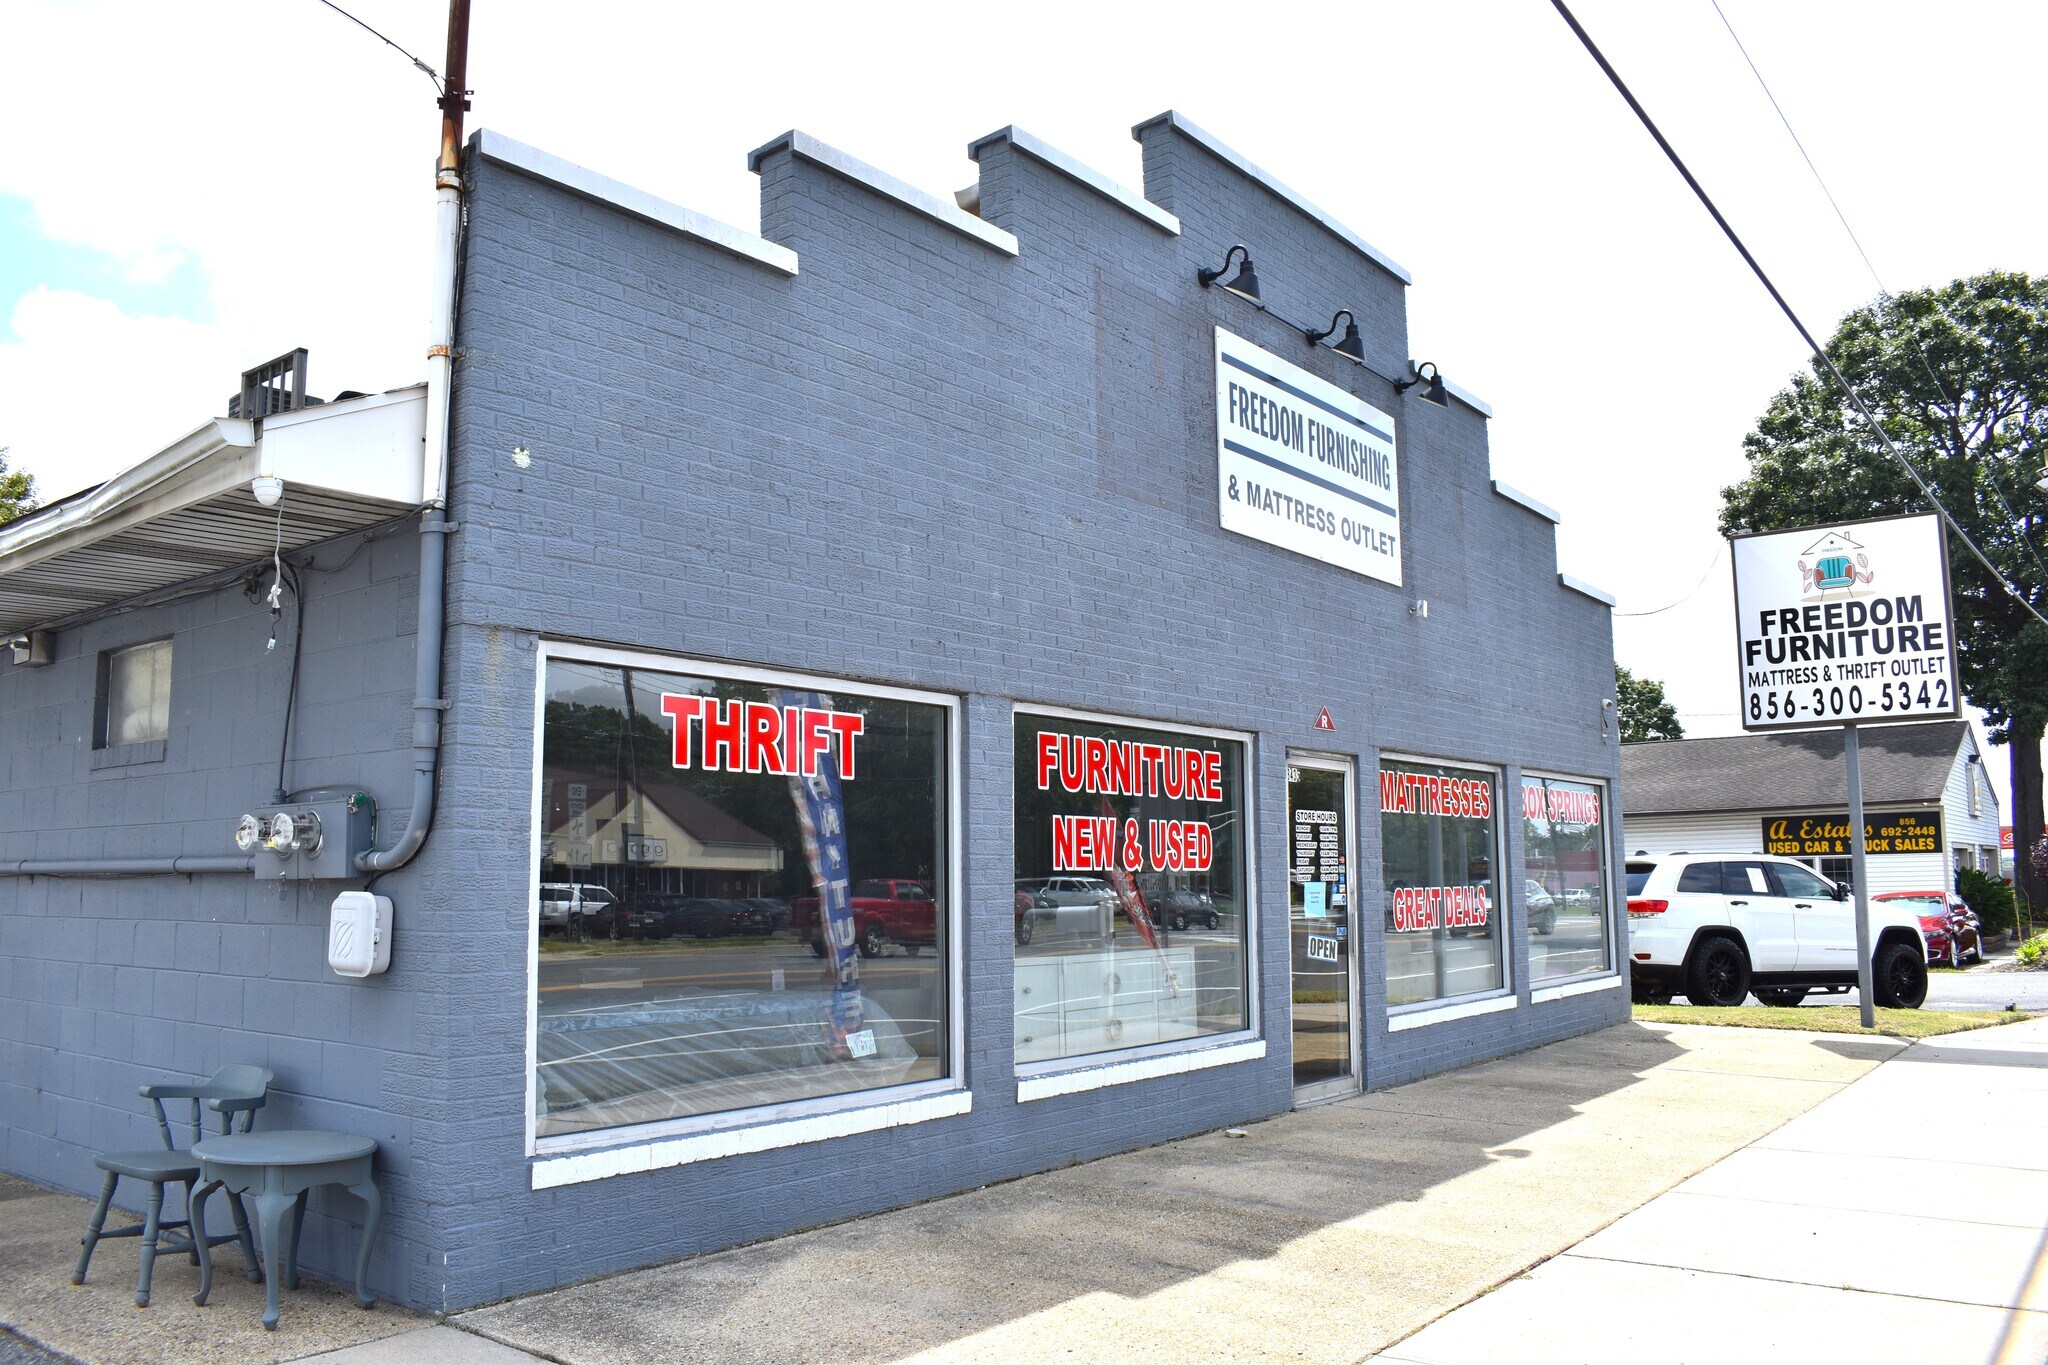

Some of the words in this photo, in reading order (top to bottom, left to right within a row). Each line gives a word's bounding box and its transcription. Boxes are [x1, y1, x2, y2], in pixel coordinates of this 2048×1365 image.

[1229, 382, 1304, 454] FREEDOM
[1308, 418, 1390, 492] FURNISHING
[1228, 474, 1240, 502] &
[1247, 481, 1336, 536] MATTRESS
[1341, 518, 1396, 558] OUTLET
[1760, 595, 1923, 636] FREEDOM
[1746, 623, 1944, 666] FURNITURE
[1748, 666, 1818, 688] MATTRESS
[1824, 665, 1832, 682] &
[1837, 661, 1886, 680] THRIFT
[1891, 656, 1945, 676] OUTLET
[1750, 679, 1949, 721] 856-300-5342
[660, 692, 864, 780] THRIFT
[1322, 715, 1328, 728] R
[1037, 731, 1223, 802] FURNITURE
[1380, 770, 1490, 819] MATTRESSES
[1522, 785, 1546, 821] BOX
[1548, 788, 1599, 825] SPRINGS
[1296, 811, 1316, 822] STORE
[1317, 812, 1336, 823] HOURS
[1881, 826, 1936, 836] 692-2448
[1052, 815, 1116, 872] NEW
[1123, 820, 1143, 872] &
[1149, 819, 1213, 872] USED
[1768, 841, 1800, 854] USED
[1804, 841, 1829, 853] CAR
[1835, 840, 1843, 852] &
[1848, 838, 1890, 851] UCK
[1895, 838, 1935, 851] SALES
[1393, 887, 1441, 932] GREAT
[1444, 885, 1487, 928] DEALS
[1310, 938, 1336, 959] OPEN
